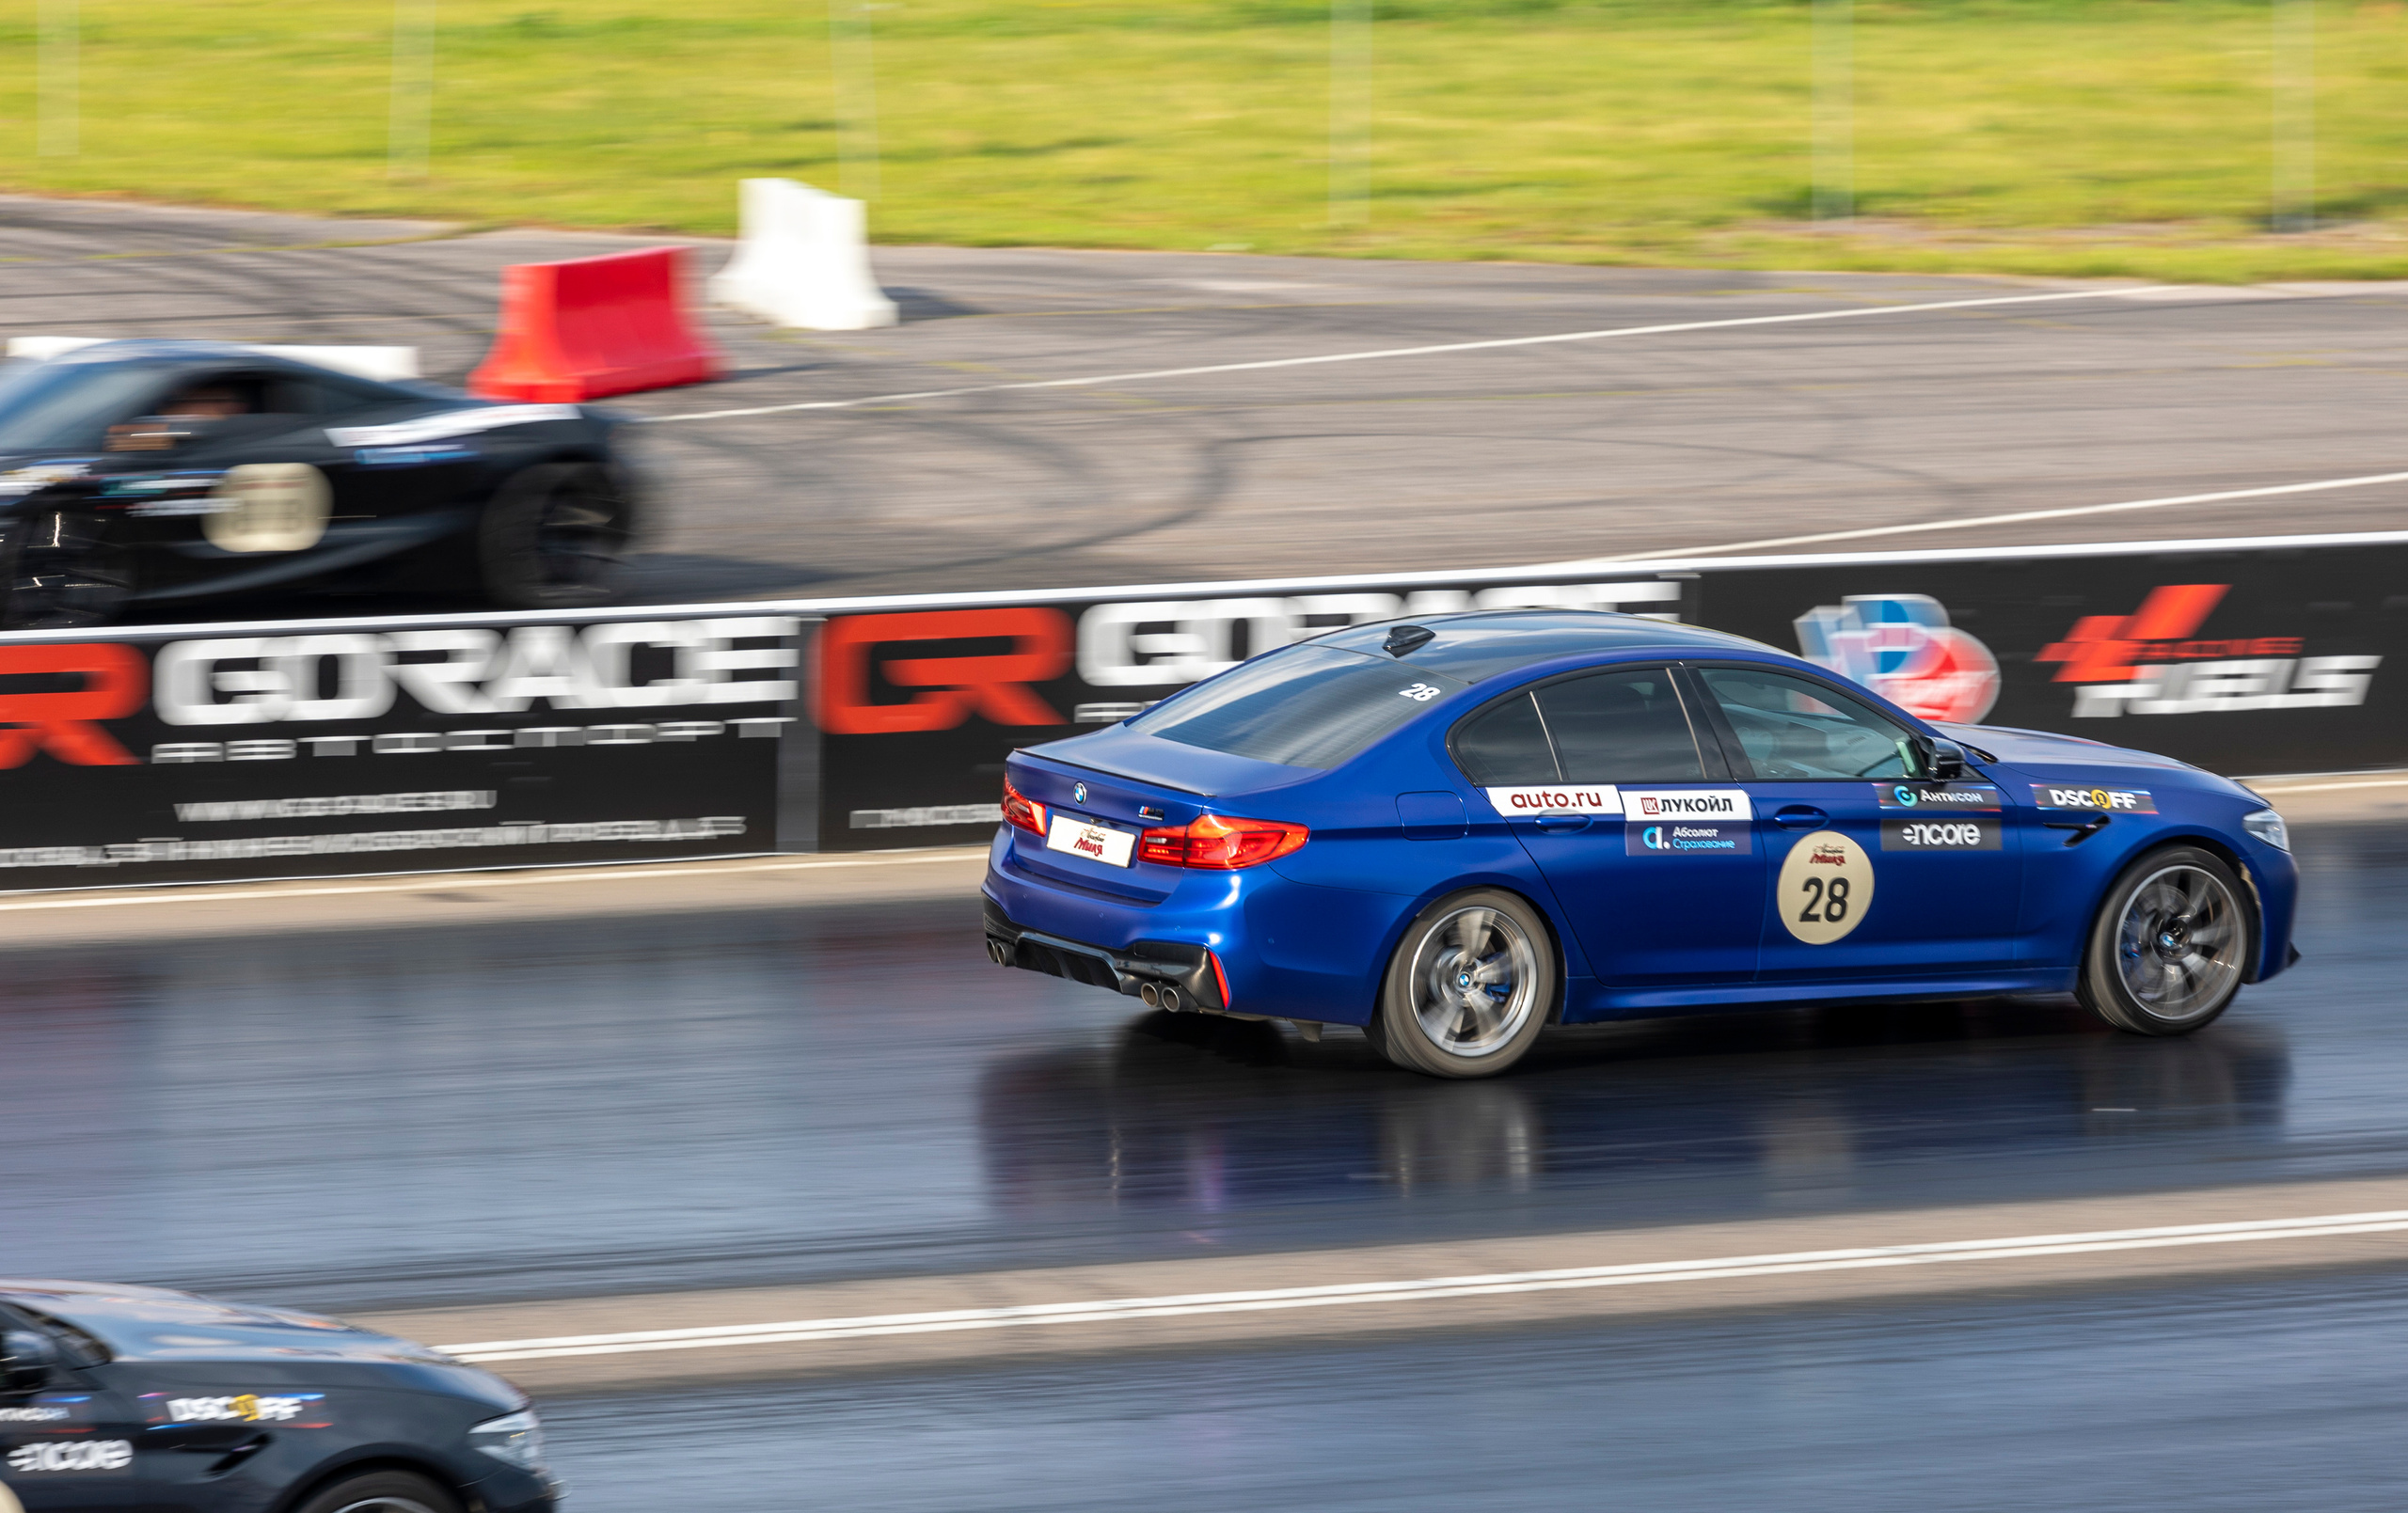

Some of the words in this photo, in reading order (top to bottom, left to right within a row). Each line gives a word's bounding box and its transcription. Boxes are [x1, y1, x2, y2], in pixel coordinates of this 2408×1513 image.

[153, 615, 800, 726] GORACE
[1399, 683, 1441, 701] 28
[1511, 790, 1603, 809] auto.ru
[1660, 796, 1735, 812] ЛУКОЙЛ
[2049, 789, 2137, 810] DSCOFF
[1672, 827, 1719, 838] Абсолют
[1902, 823, 1982, 845] encore
[1672, 838, 1735, 851] Страхование
[1798, 876, 1850, 923] 28
